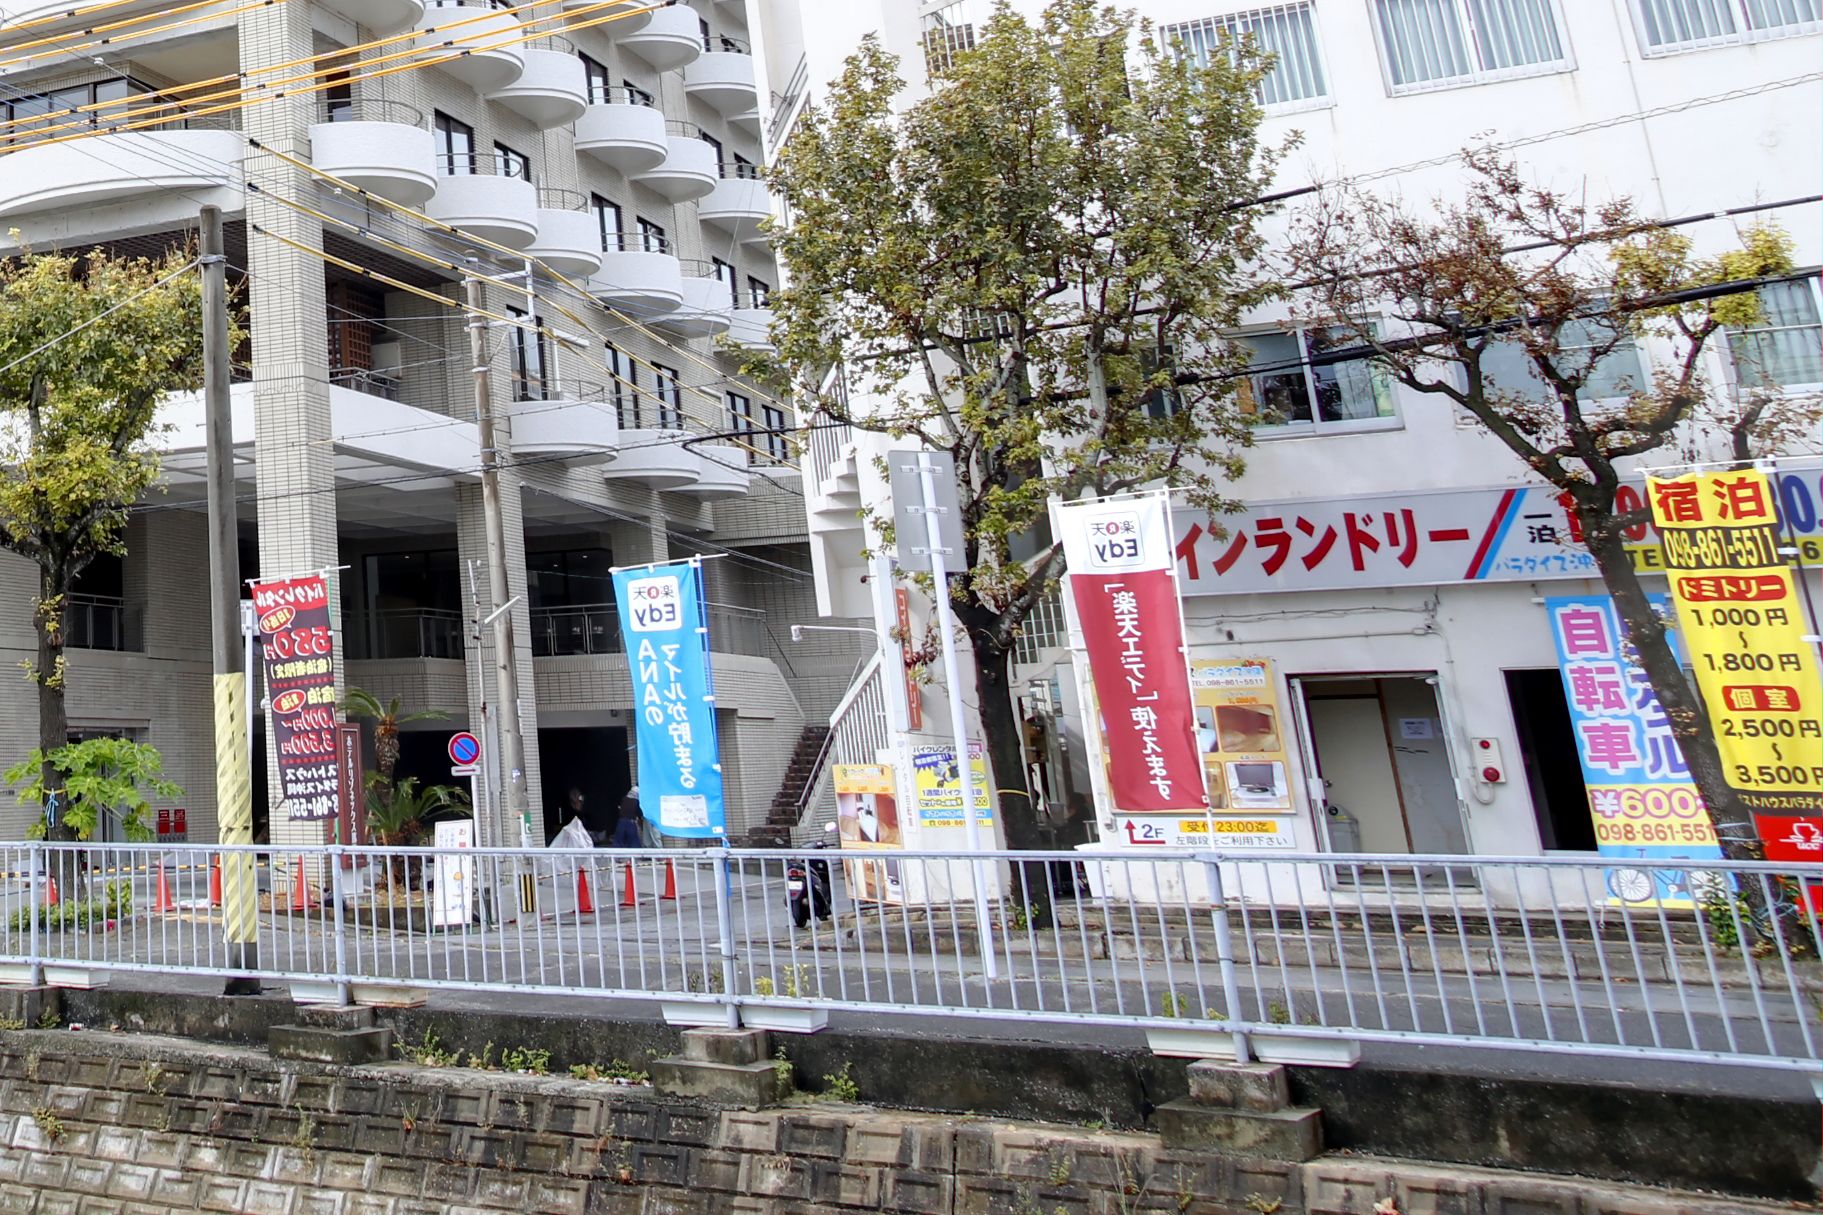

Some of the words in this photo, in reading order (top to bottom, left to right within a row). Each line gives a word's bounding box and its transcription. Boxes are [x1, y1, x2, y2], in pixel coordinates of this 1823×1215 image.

[1654, 476, 1767, 522] 宿泊
[1663, 527, 1778, 567] 098-861-5511
[1496, 552, 1597, 575] パラダイス沖
[1680, 579, 1782, 598] ドミトリー
[1560, 609, 1637, 770] 自転車
[1730, 688, 1793, 709] 個室
[1738, 794, 1823, 808] ストハウスパラダイ
[1141, 824, 1164, 838] 2F
[1599, 823, 1716, 842] 098-861-551
